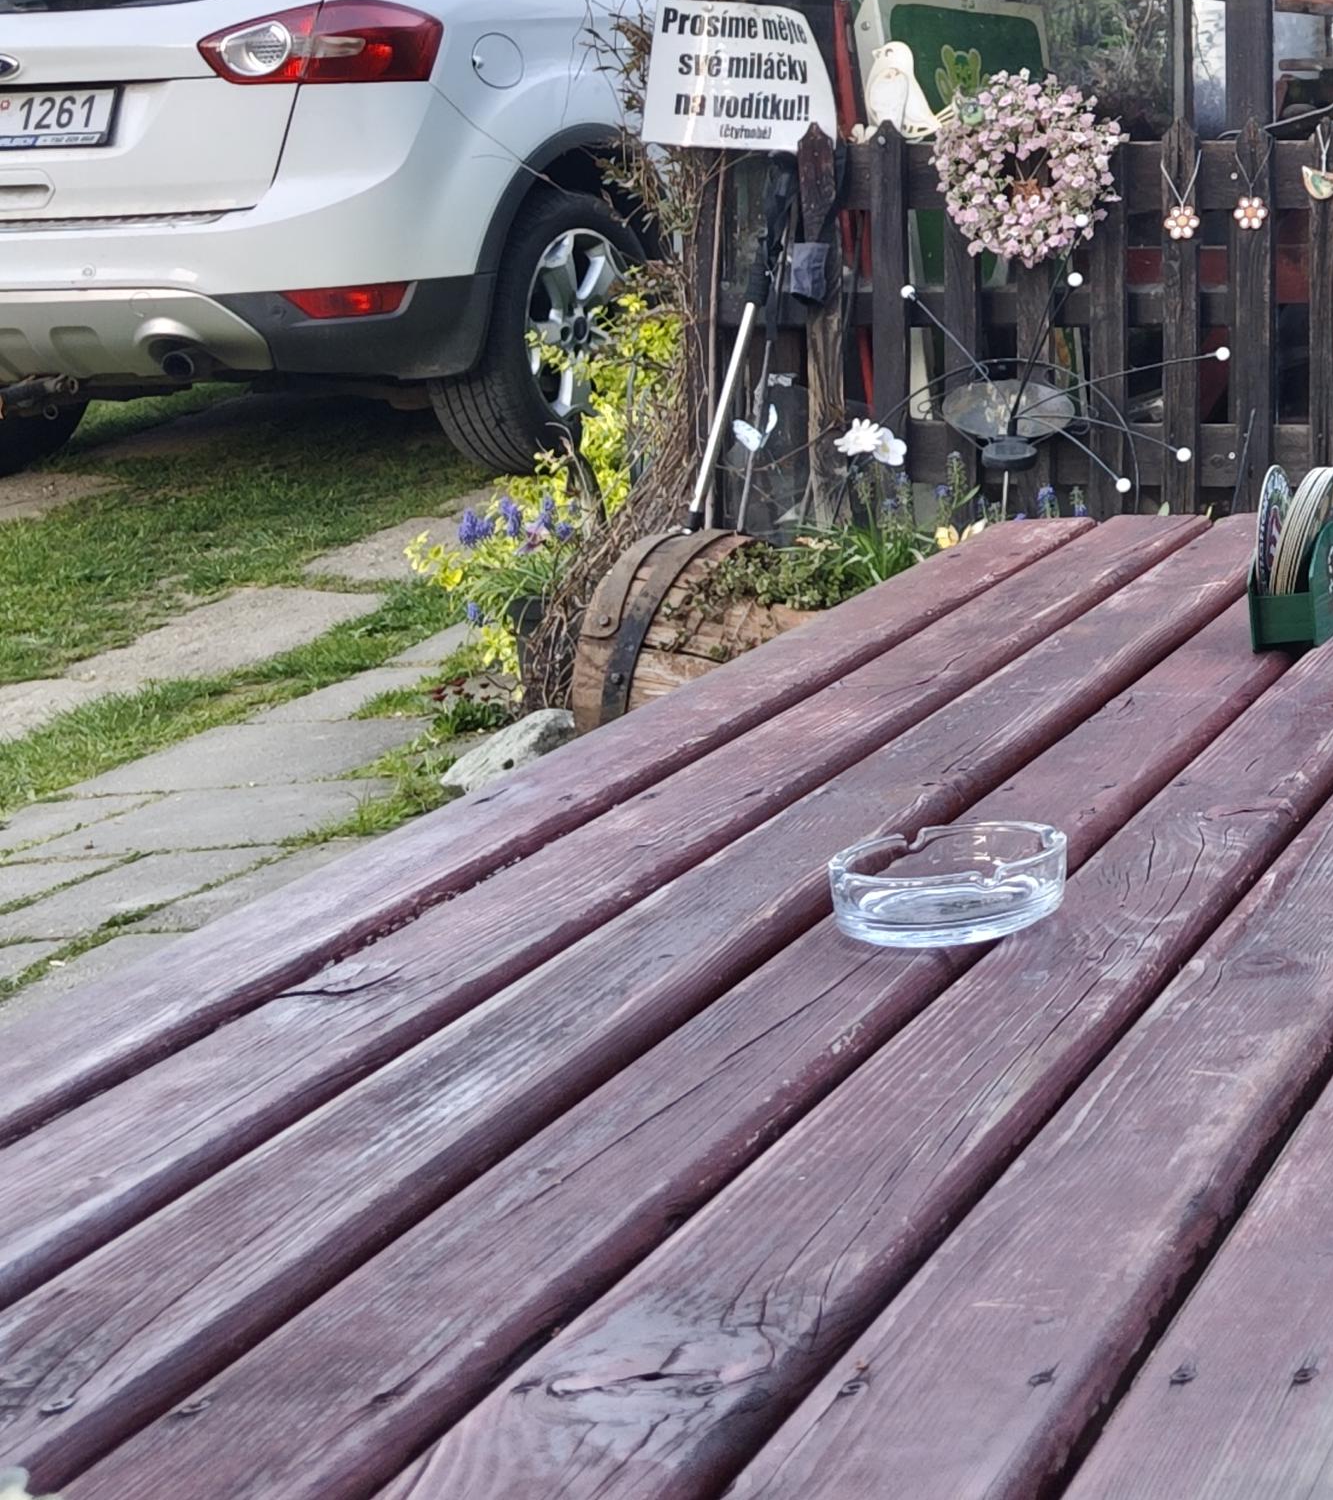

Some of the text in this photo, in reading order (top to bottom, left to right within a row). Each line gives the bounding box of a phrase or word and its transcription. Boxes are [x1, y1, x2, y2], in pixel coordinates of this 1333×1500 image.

[661, 7, 808, 45] Prosíme mějte
[678, 50, 808, 85] své miláčky
[19, 94, 96, 131] 1261
[674, 91, 810, 122] na vodítku!!
